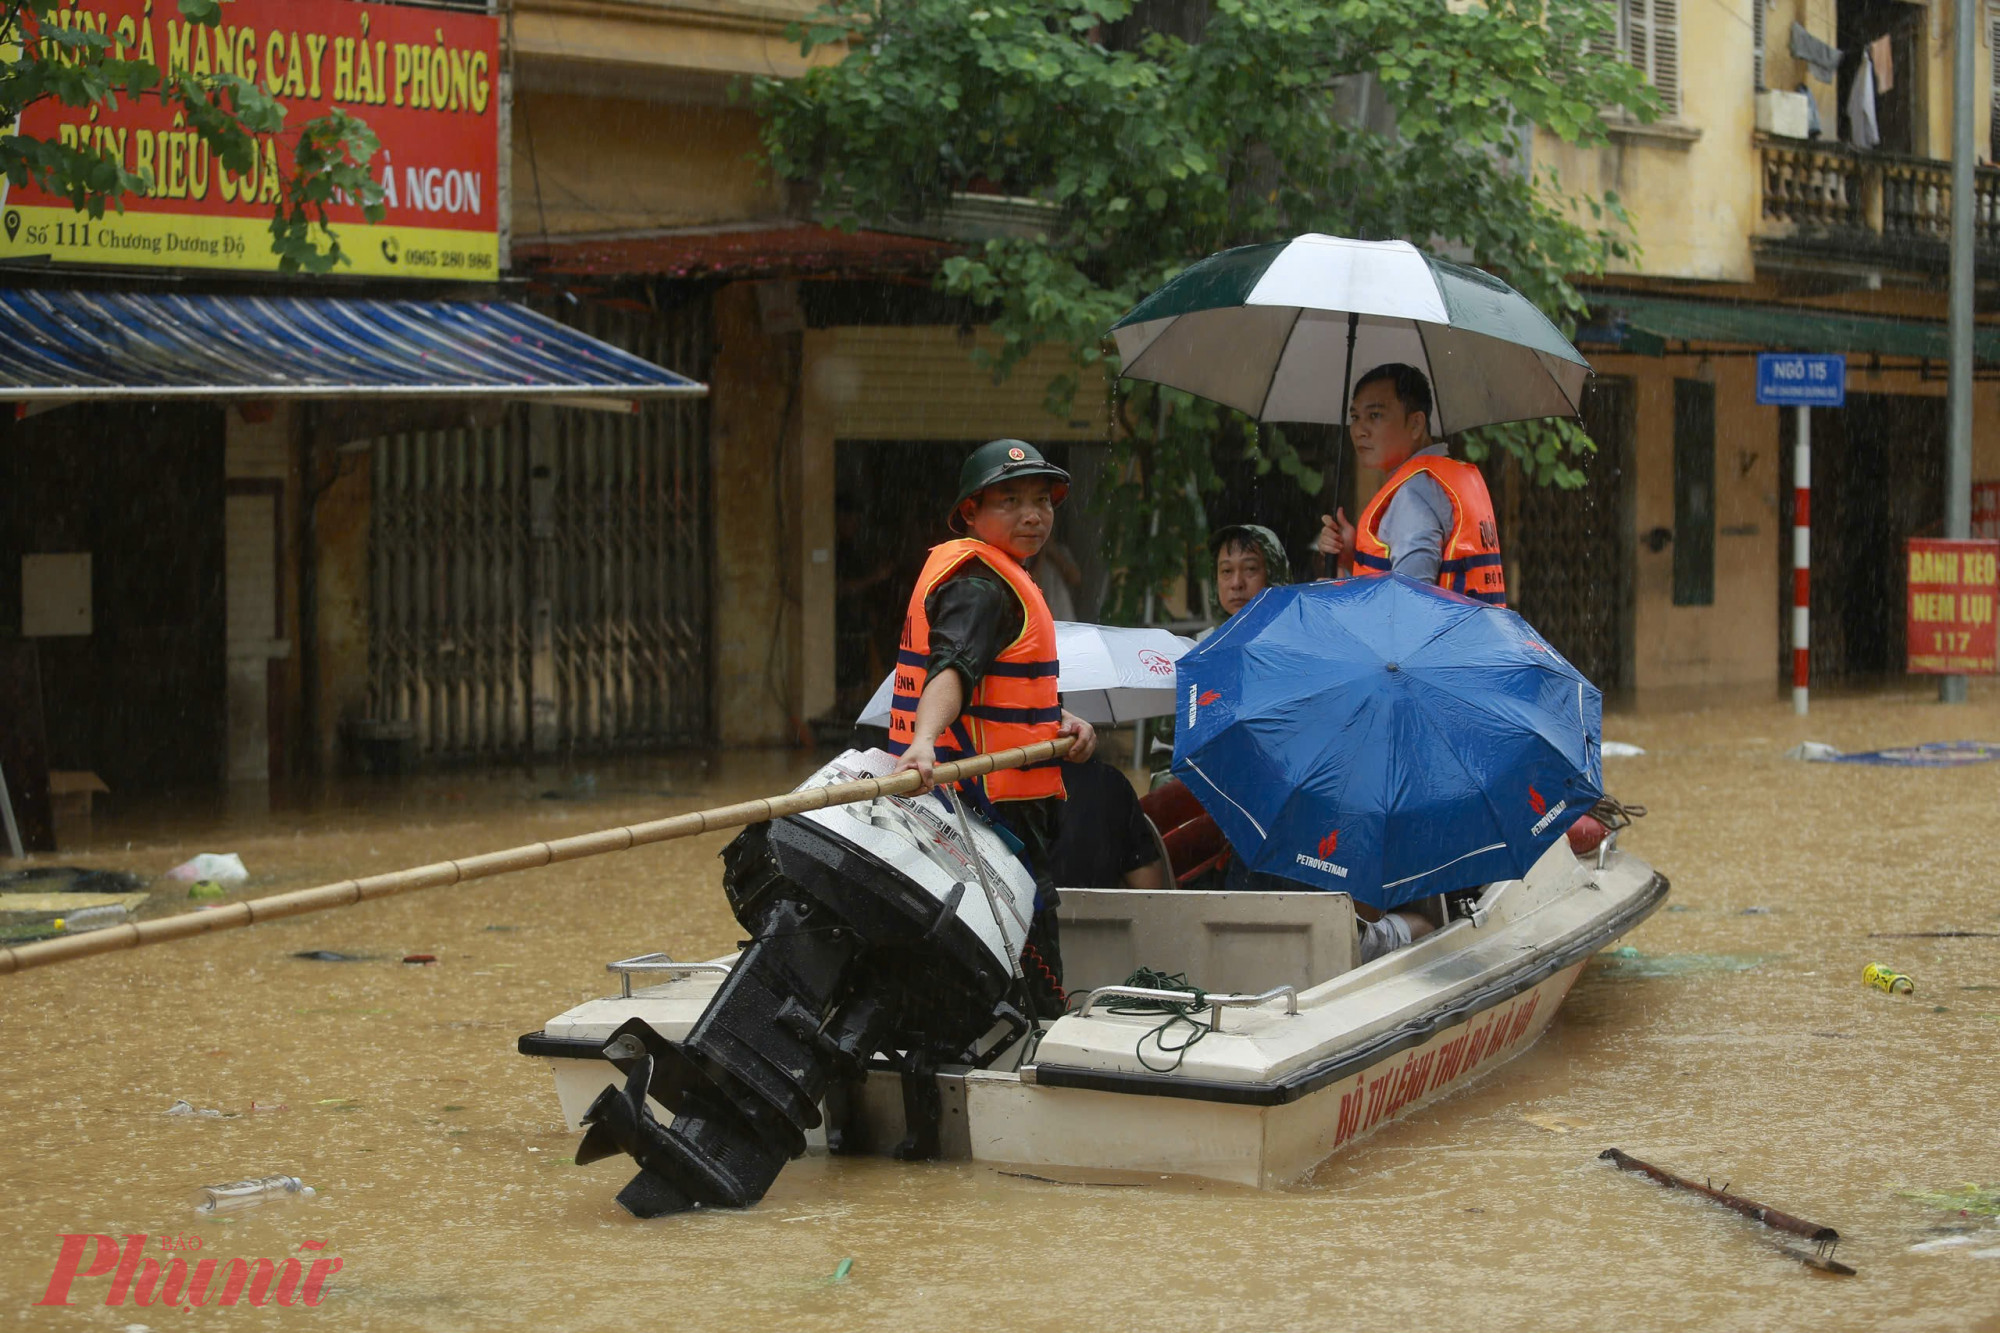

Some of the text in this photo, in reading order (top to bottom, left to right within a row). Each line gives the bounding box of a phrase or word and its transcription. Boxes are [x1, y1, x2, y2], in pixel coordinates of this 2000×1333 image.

[265, 29, 327, 99] CAY
[334, 11, 387, 105] HẢI
[394, 28, 489, 113] PHÒNG
[136, 111, 209, 199] RIÊU
[406, 166, 481, 215] NGON
[26, 224, 49, 245] Số
[56, 222, 91, 247] 111
[98, 228, 162, 255] Chương
[1934, 632, 1971, 652] 117
[1150, 664, 1174, 676] AIA
[1295, 853, 1349, 878] PETROVIETNAM
